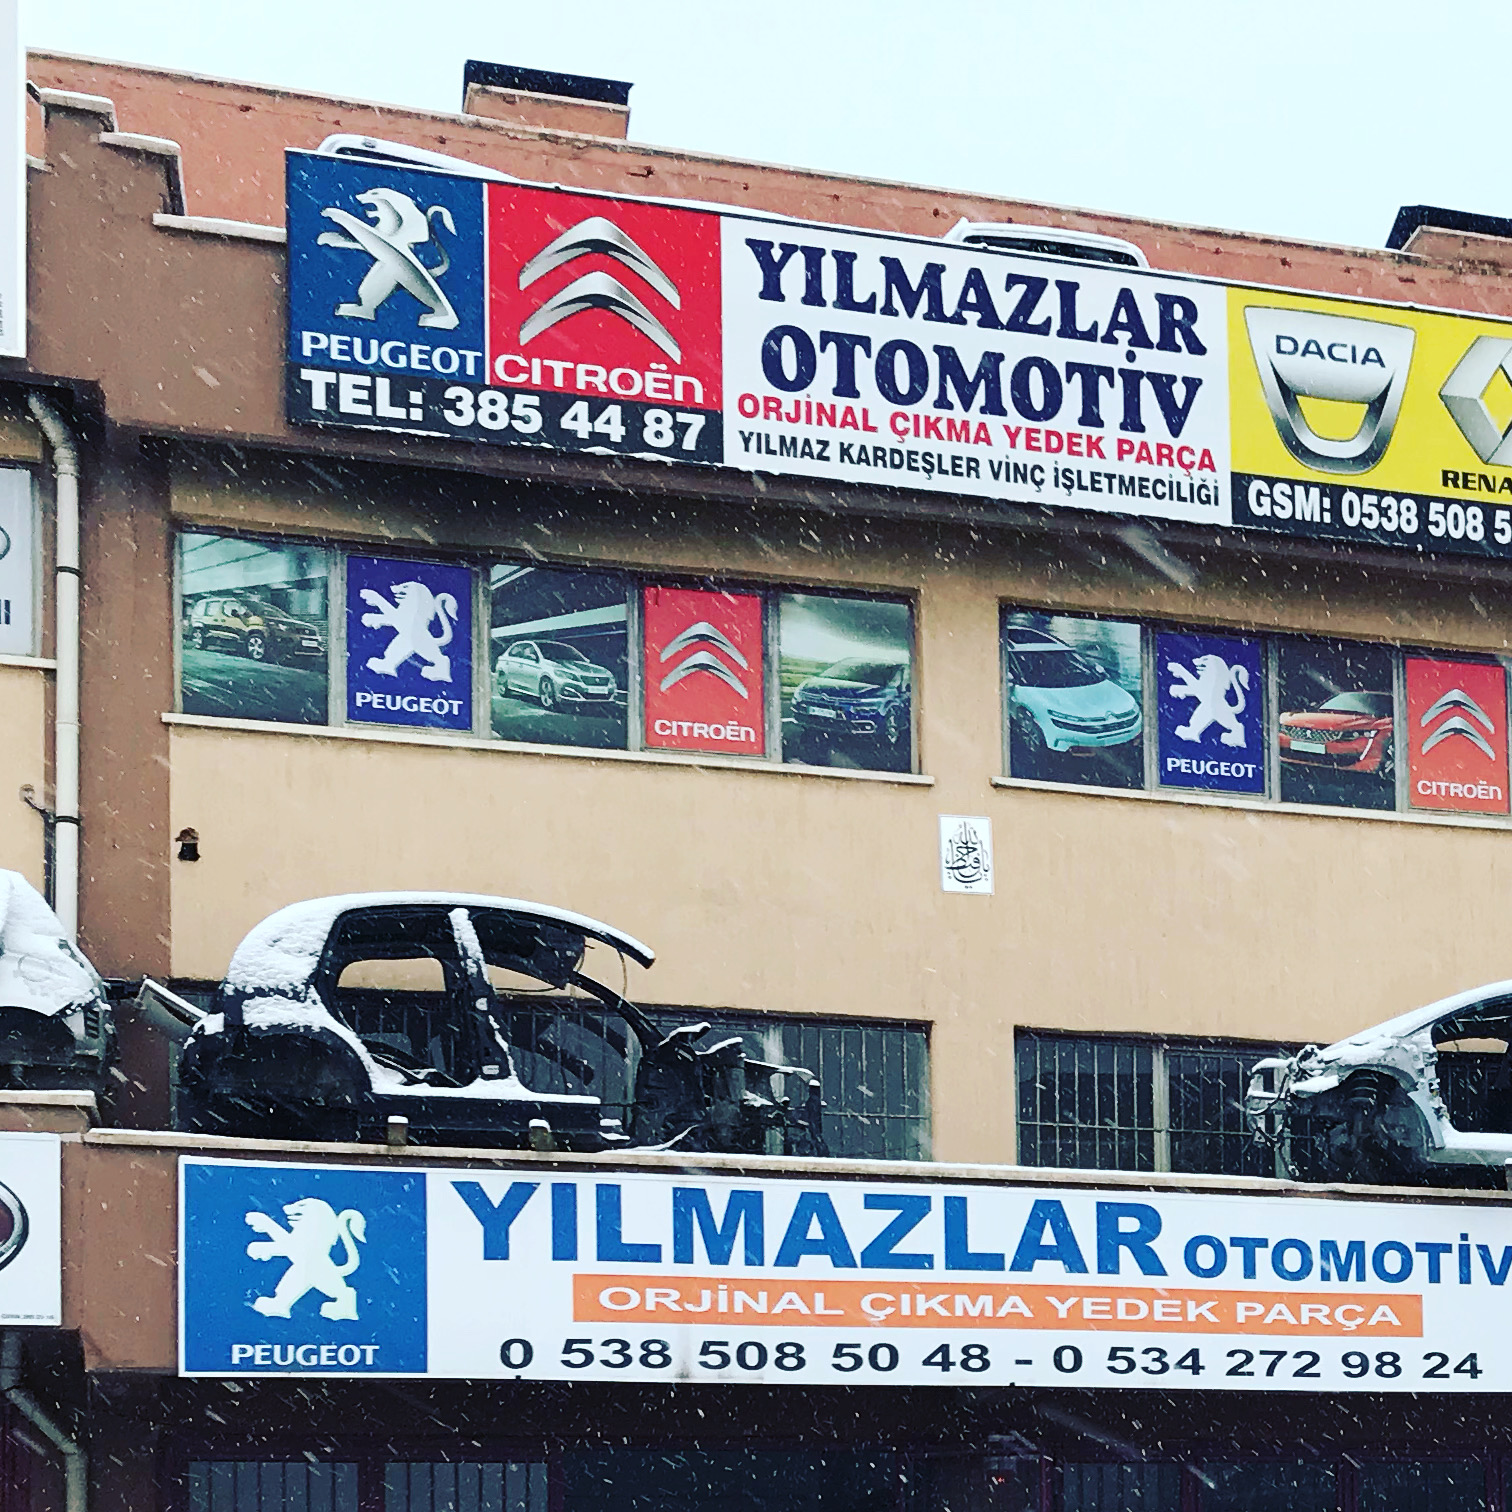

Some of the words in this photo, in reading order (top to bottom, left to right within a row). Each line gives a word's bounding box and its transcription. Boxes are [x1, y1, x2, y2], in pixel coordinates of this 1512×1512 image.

[745, 238, 1207, 356] YILMAZLAR
[301, 330, 483, 376] PEUGEOT
[1275, 334, 1386, 369] DACIA
[761, 324, 1203, 438] OTOMOTİV
[300, 369, 423, 421] TEL:
[443, 386, 543, 434] 385
[560, 403, 626, 442] 44
[642, 410, 706, 451] 87
[737, 392, 878, 433] ORJİNAL
[889, 411, 992, 446] ÇIKMA
[1003, 424, 1107, 459] YEDEK
[1117, 439, 1217, 475] PARÇA
[738, 430, 830, 463] YILMAZ
[839, 442, 980, 480] KARDEŞLER
[990, 454, 1046, 493] VİNÇ
[1053, 460, 1220, 507] İŞLETMECİLİĞİ
[1248, 480, 1331, 524] GSM:
[1342, 491, 1418, 534] 0538
[1428, 502, 1484, 542] 508
[355, 692, 463, 716] PEUGEOT
[1166, 757, 1256, 779] PEUGEOT
[450, 1181, 1168, 1276] YILMAZLAR
[598, 1283, 844, 1317] ORJİNAL
[860, 1291, 1034, 1323] ÇIKMA
[1046, 1297, 1220, 1324] YEDEK
[1236, 1301, 1402, 1331] PARÇA
[231, 1343, 380, 1367] PEUGEOT
[500, 1337, 534, 1369] 0
[560, 1338, 673, 1370] 538
[698, 1340, 807, 1372] 508
[831, 1342, 900, 1372] 50
[921, 1343, 992, 1373] 48
[1052, 1344, 1084, 1374] 0
[1106, 1347, 1205, 1376] 534
[1225, 1349, 1321, 1378] 272
[1341, 1351, 1401, 1379] 98
[1421, 1352, 1483, 1380] 24
